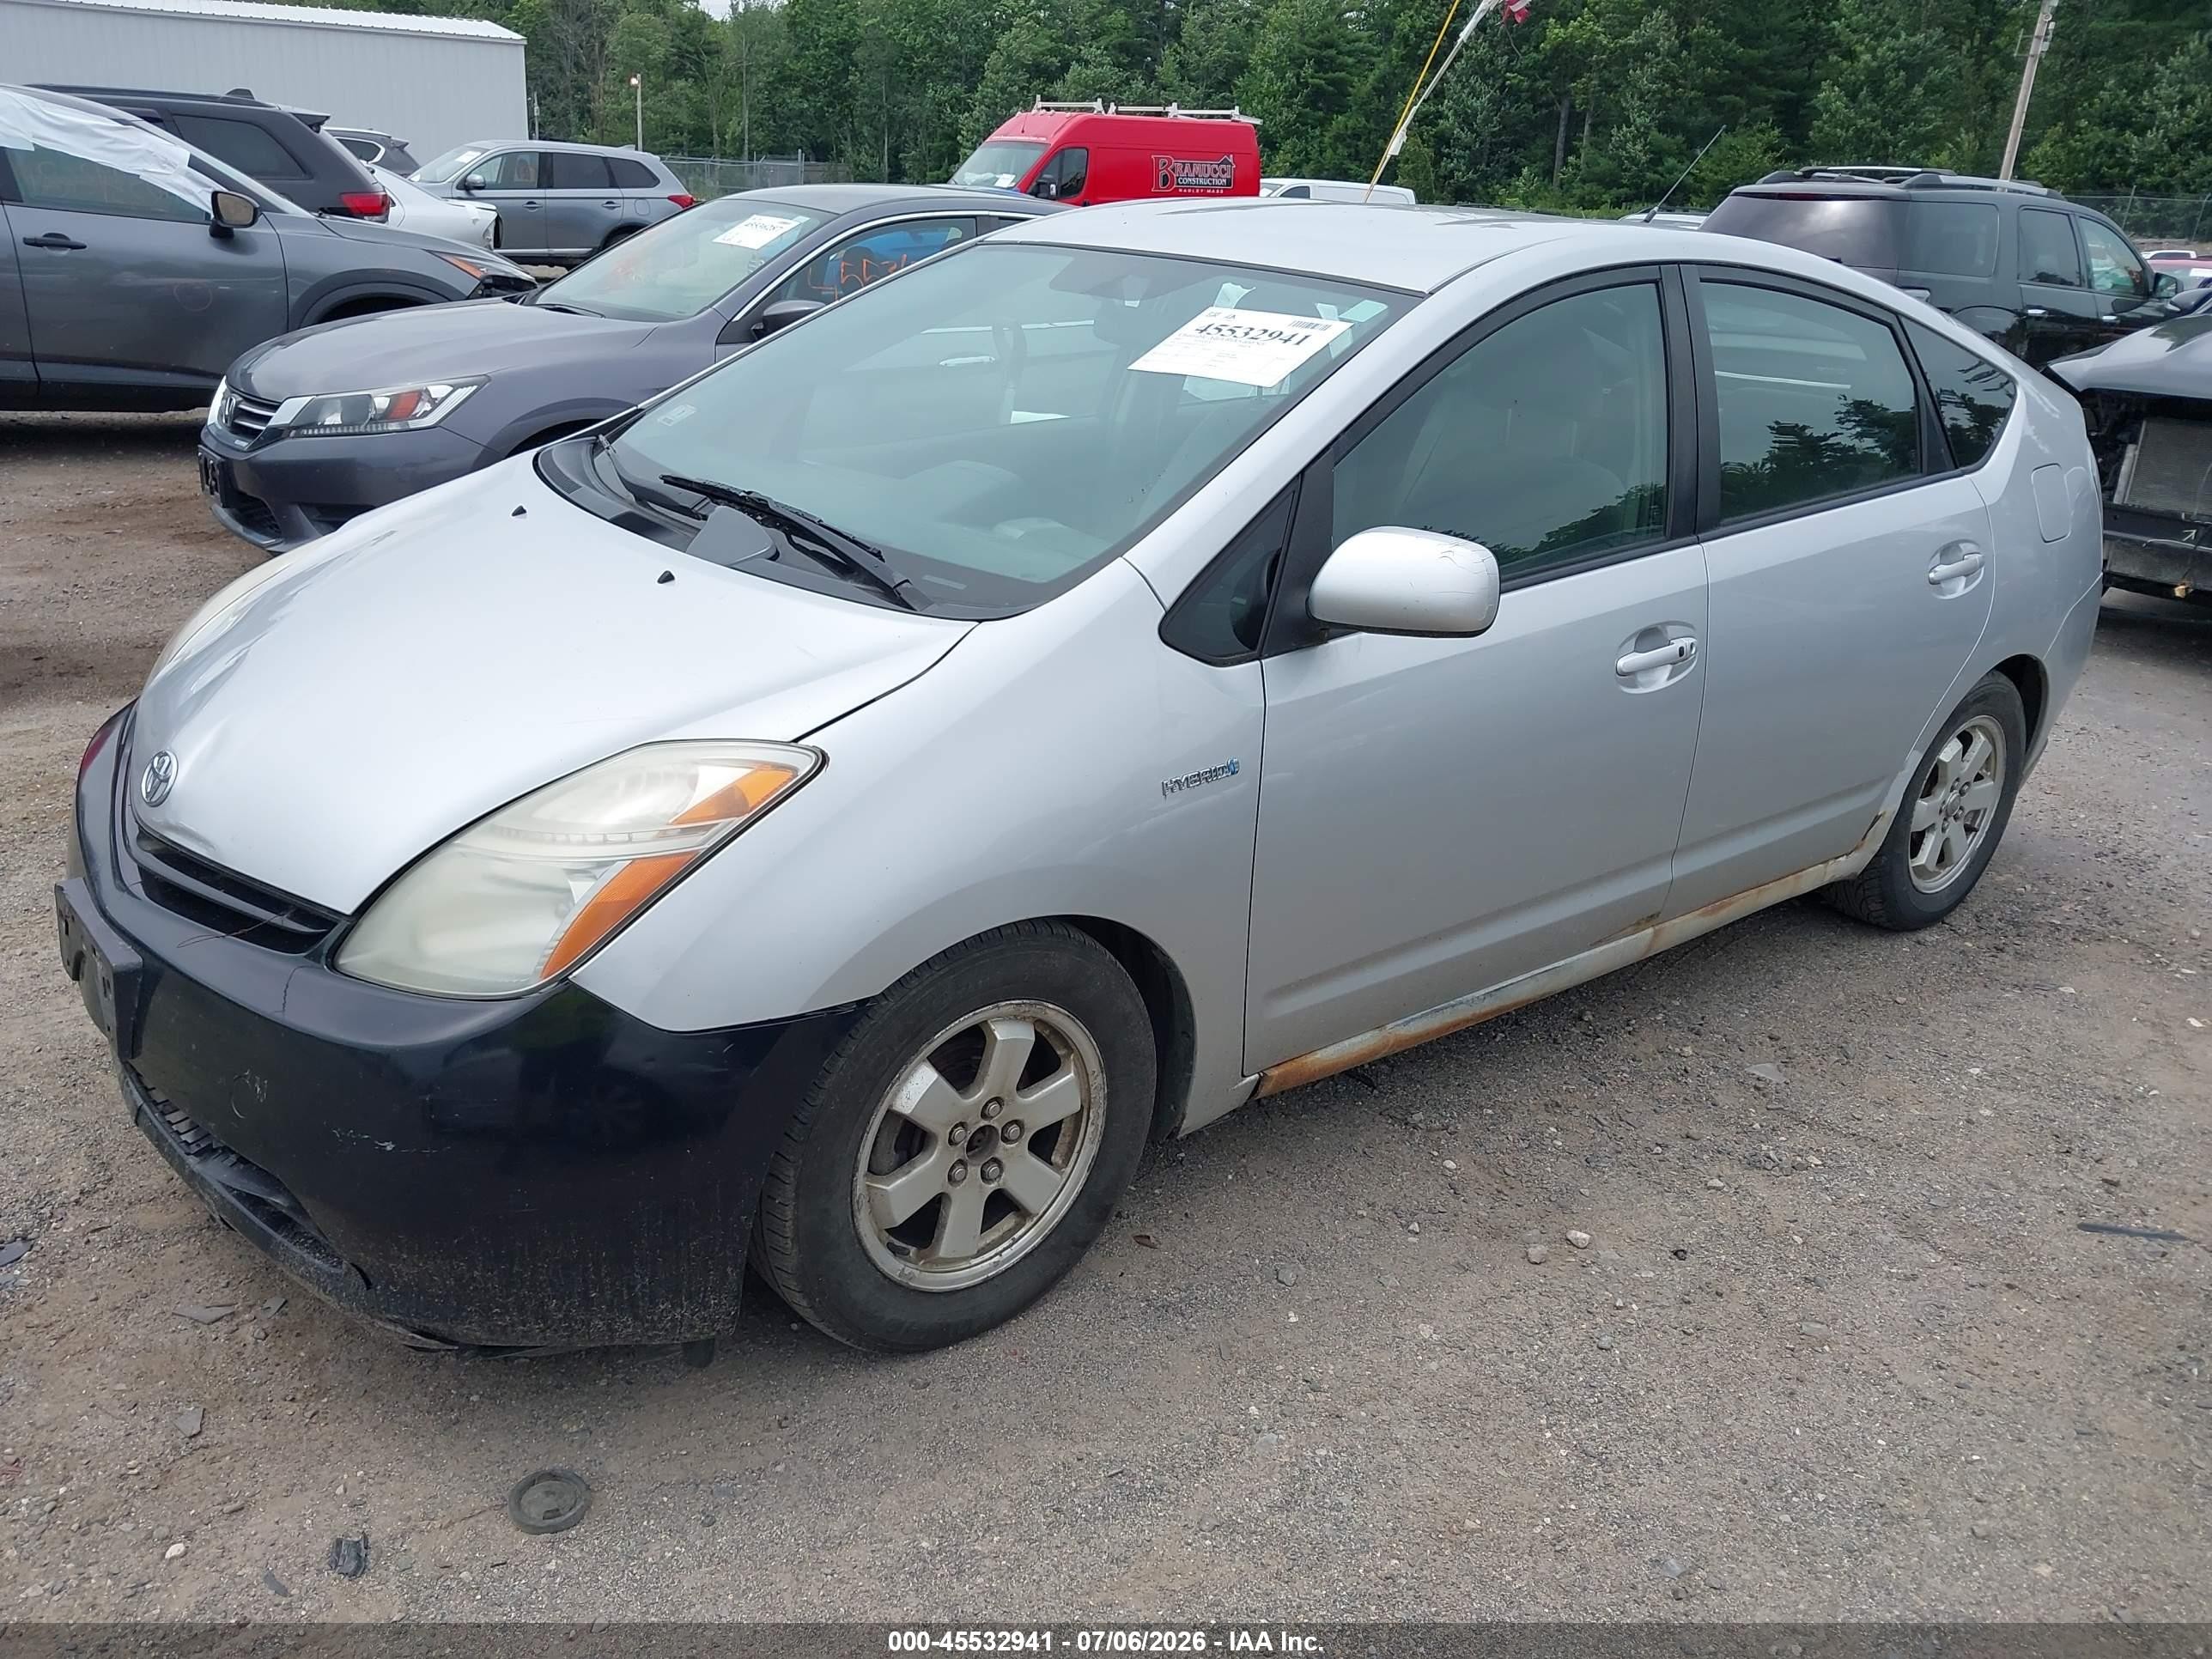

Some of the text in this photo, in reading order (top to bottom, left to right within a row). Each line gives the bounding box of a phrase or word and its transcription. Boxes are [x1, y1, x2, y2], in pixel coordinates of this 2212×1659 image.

[1152, 155, 1231, 191] BRAMUCCI
[1177, 177, 1226, 186] CONSTRUCTION
[1195, 323, 1313, 346] 45532941
[1161, 763, 1229, 797] HYBRID
